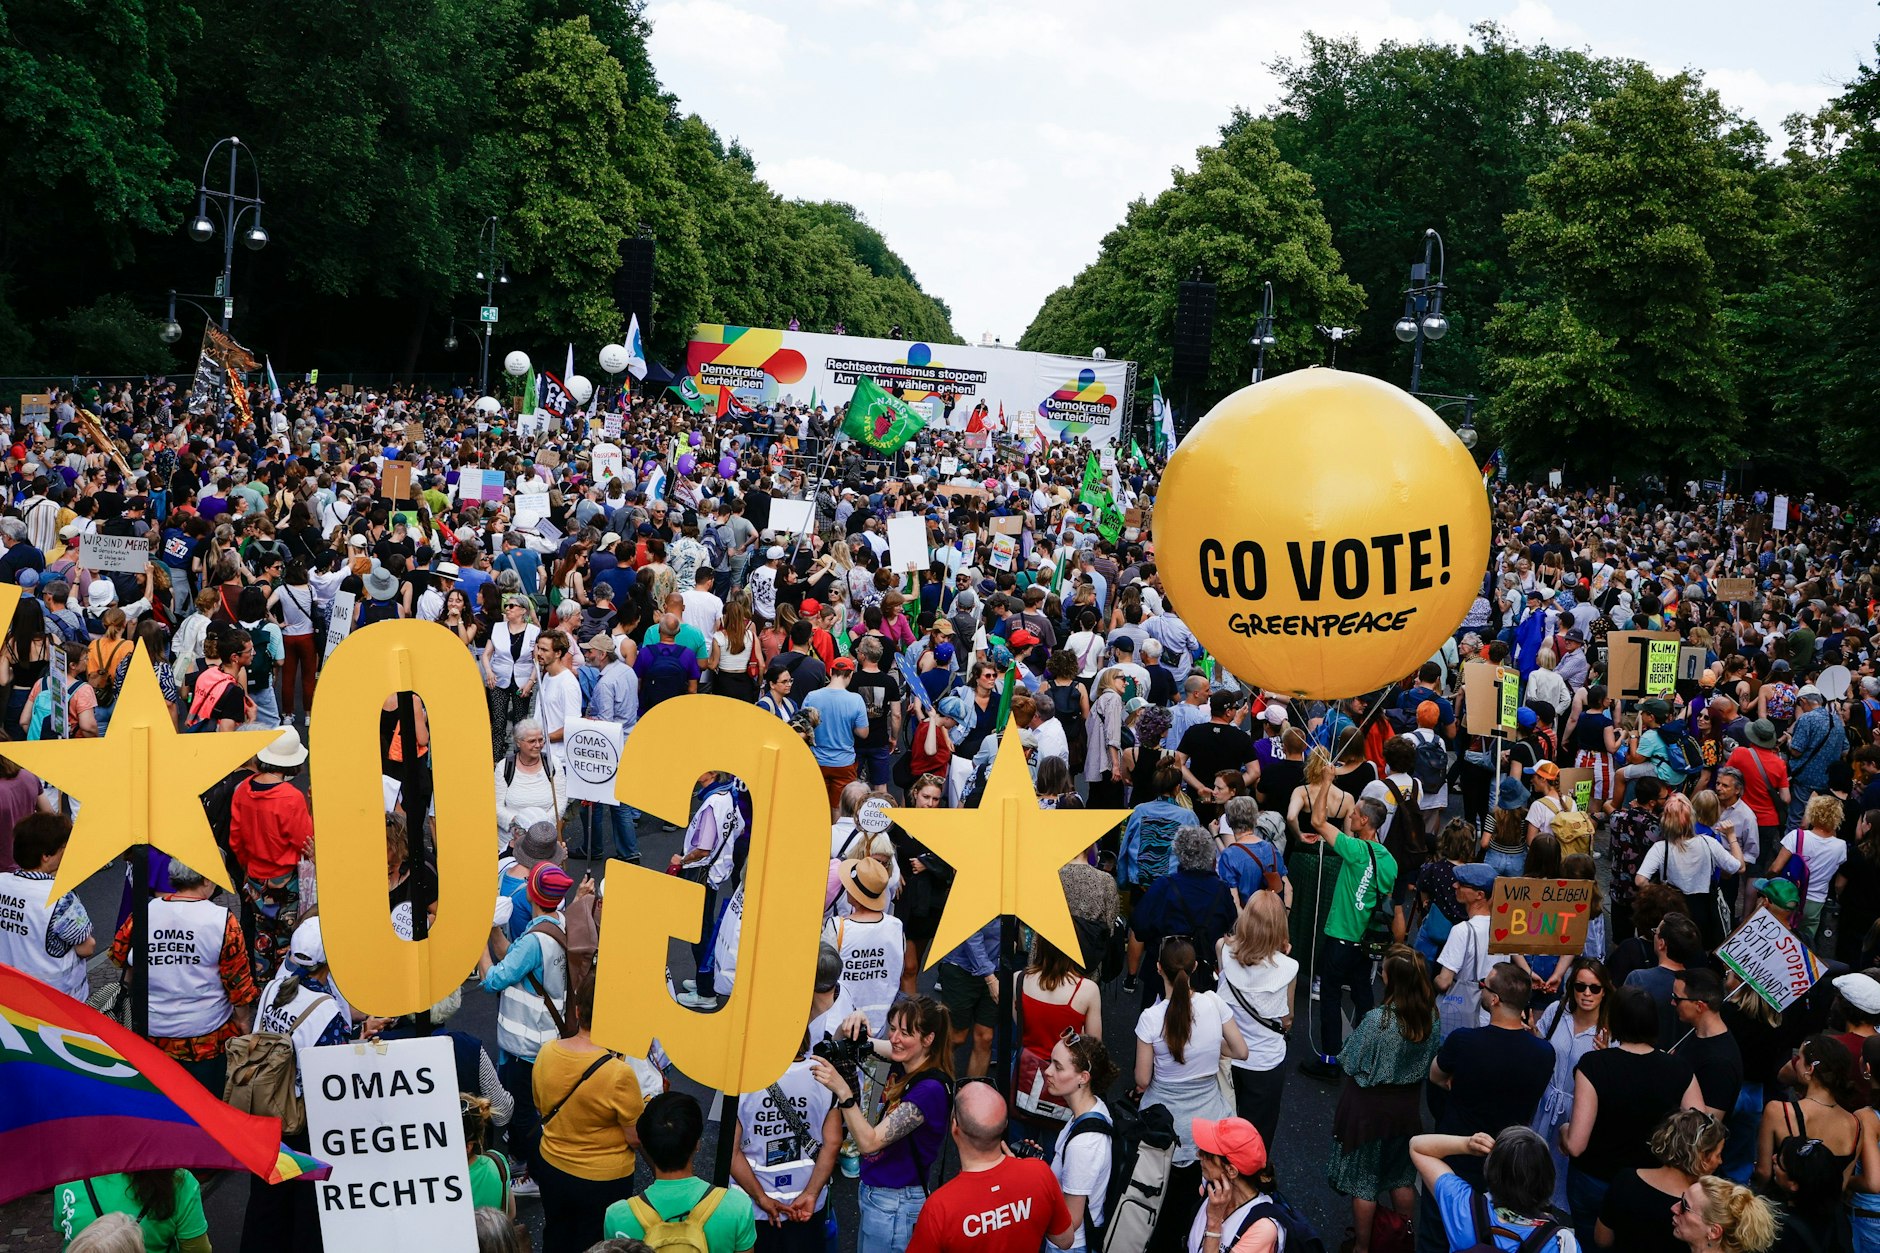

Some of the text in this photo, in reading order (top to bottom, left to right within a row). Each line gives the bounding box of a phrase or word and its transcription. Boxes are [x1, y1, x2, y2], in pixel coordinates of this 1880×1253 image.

[700, 363, 764, 378] Demokratie
[827, 358, 987, 384] Rechtsextremismus stoppen!
[702, 375, 763, 389] verteidigen
[836, 373, 855, 384] Am
[937, 383, 976, 395] gehen!
[1046, 398, 1111, 414] Demokratie
[1048, 411, 1110, 425] verteidigen
[84, 535, 149, 551] WIR SIND MEHR
[1199, 524, 1451, 602] GO VOTE!
[1228, 607, 1418, 638] GREENPEACE
[1651, 643, 1677, 653] KLIMA
[1652, 663, 1673, 673] GEGEN
[1649, 674, 1674, 684] RECHTS
[575, 734, 607, 748] OMAS
[573, 747, 609, 761] GEGEN
[574, 760, 613, 775] RECHTS
[866, 801, 889, 809] OMAS
[861, 819, 889, 828] RECHTS
[0, 893, 26, 909] MAS
[1504, 883, 1589, 903] WIR BLEIBEN
[1510, 908, 1577, 936] BUNT
[1751, 915, 1782, 940] AfD
[153, 929, 195, 941] OMAS
[1738, 925, 1777, 961] PUTIN
[147, 942, 196, 953] GEGEN
[851, 947, 885, 959] OMAS
[845, 959, 885, 970] GEGEN
[1721, 937, 1792, 1008] KLIMAWANDEL
[1775, 936, 1810, 997] STOPPEN
[843, 969, 888, 981] RECHTS
[322, 1067, 435, 1101] OMAS
[762, 1096, 808, 1109] OAS
[753, 1121, 811, 1137] RECHS
[322, 1121, 448, 1156] GEGEN
[322, 1175, 463, 1211] RECHTS
[963, 1196, 1032, 1238] CREW
